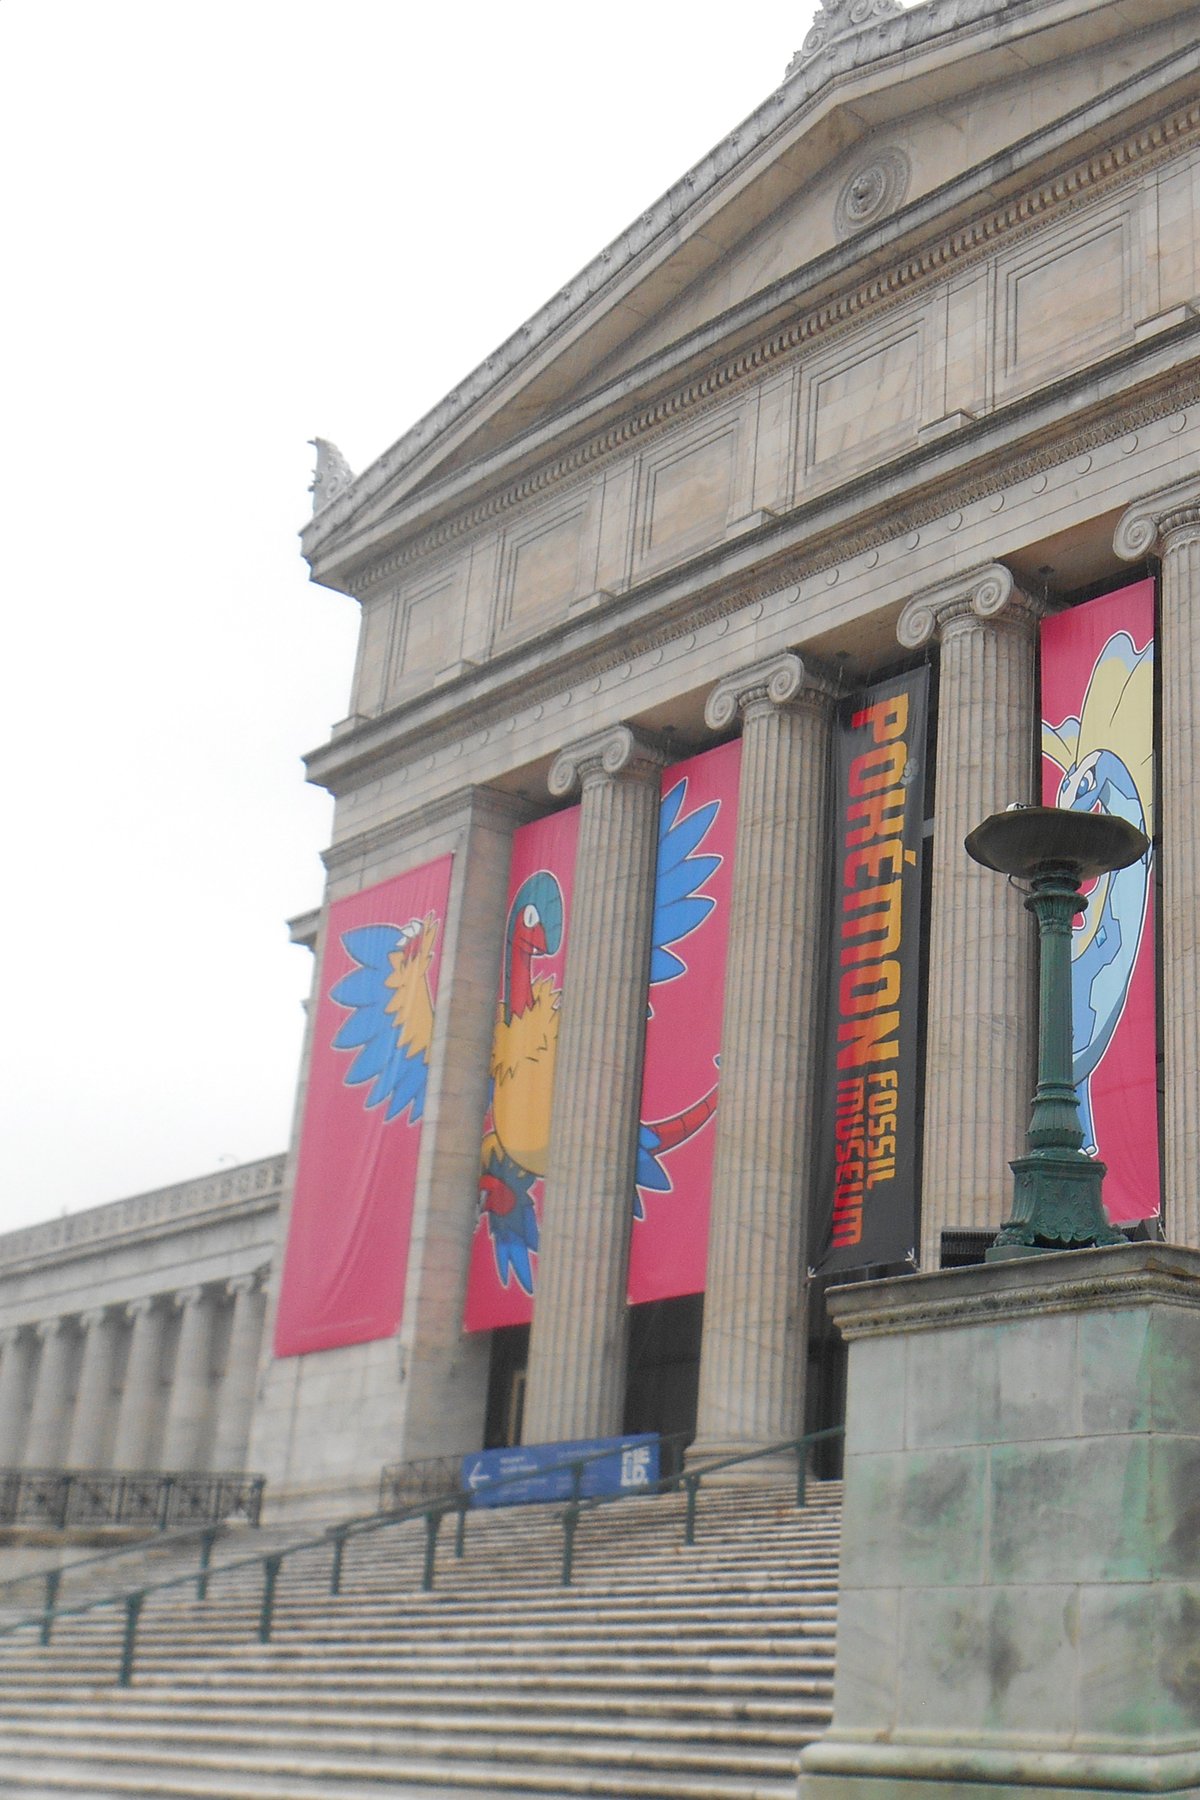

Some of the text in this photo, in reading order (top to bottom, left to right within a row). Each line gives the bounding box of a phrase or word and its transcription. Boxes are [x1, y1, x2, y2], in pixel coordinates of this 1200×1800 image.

[836, 692, 916, 1070] POKÉMON
[832, 1077, 864, 1247] MUSEUM
[866, 1069, 898, 1190] FOSSIL
